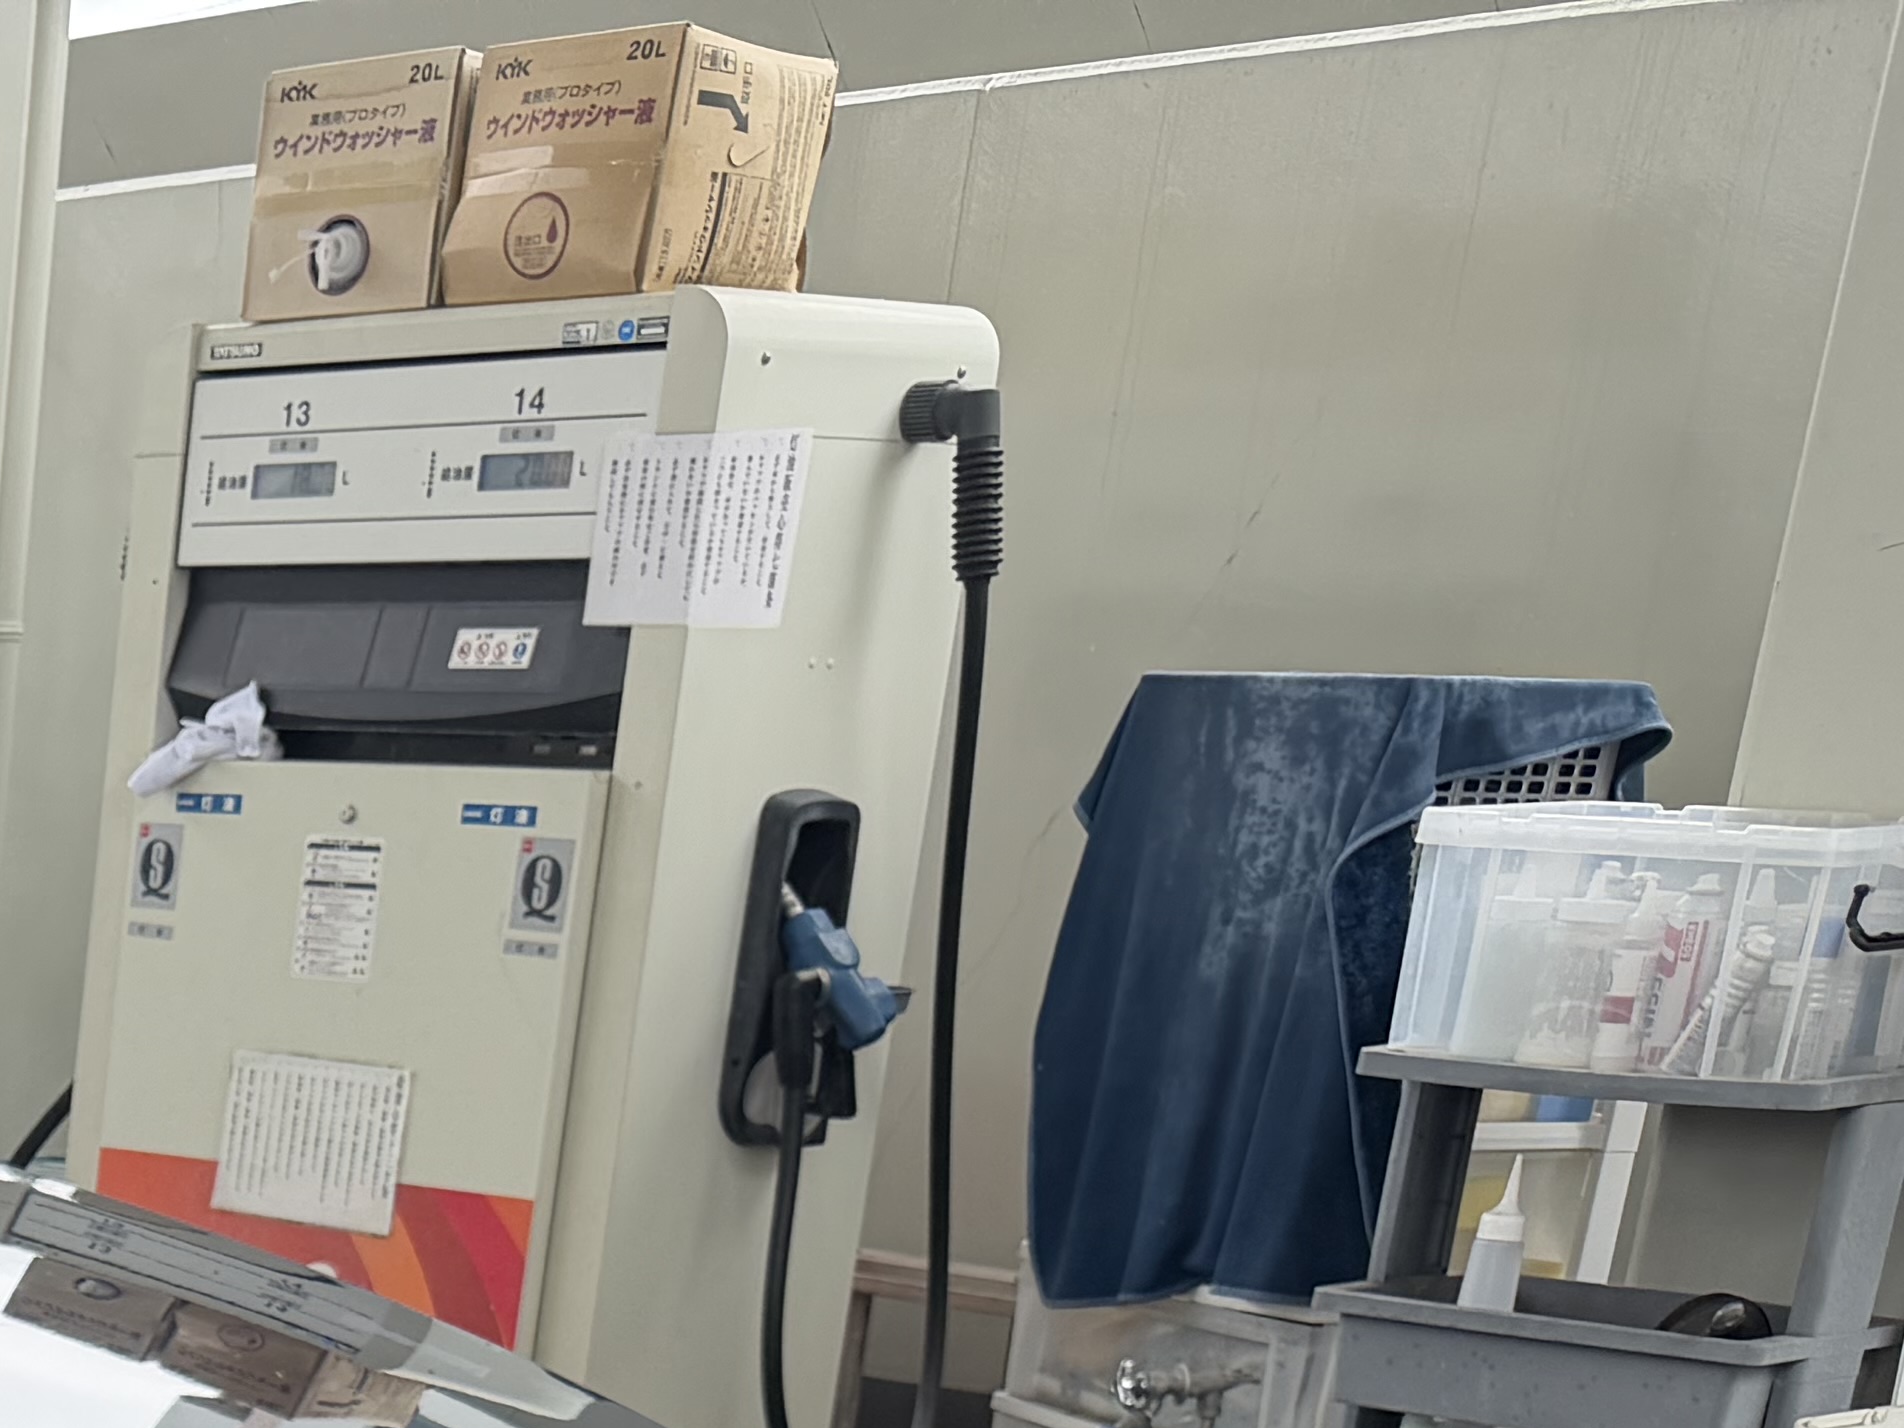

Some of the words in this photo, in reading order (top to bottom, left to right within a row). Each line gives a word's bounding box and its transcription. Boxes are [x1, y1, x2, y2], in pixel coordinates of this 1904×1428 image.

[626, 39, 666, 61] 20L
[408, 62, 444, 84] 20L
[514, 386, 546, 416] 14
[283, 400, 312, 428] 13
